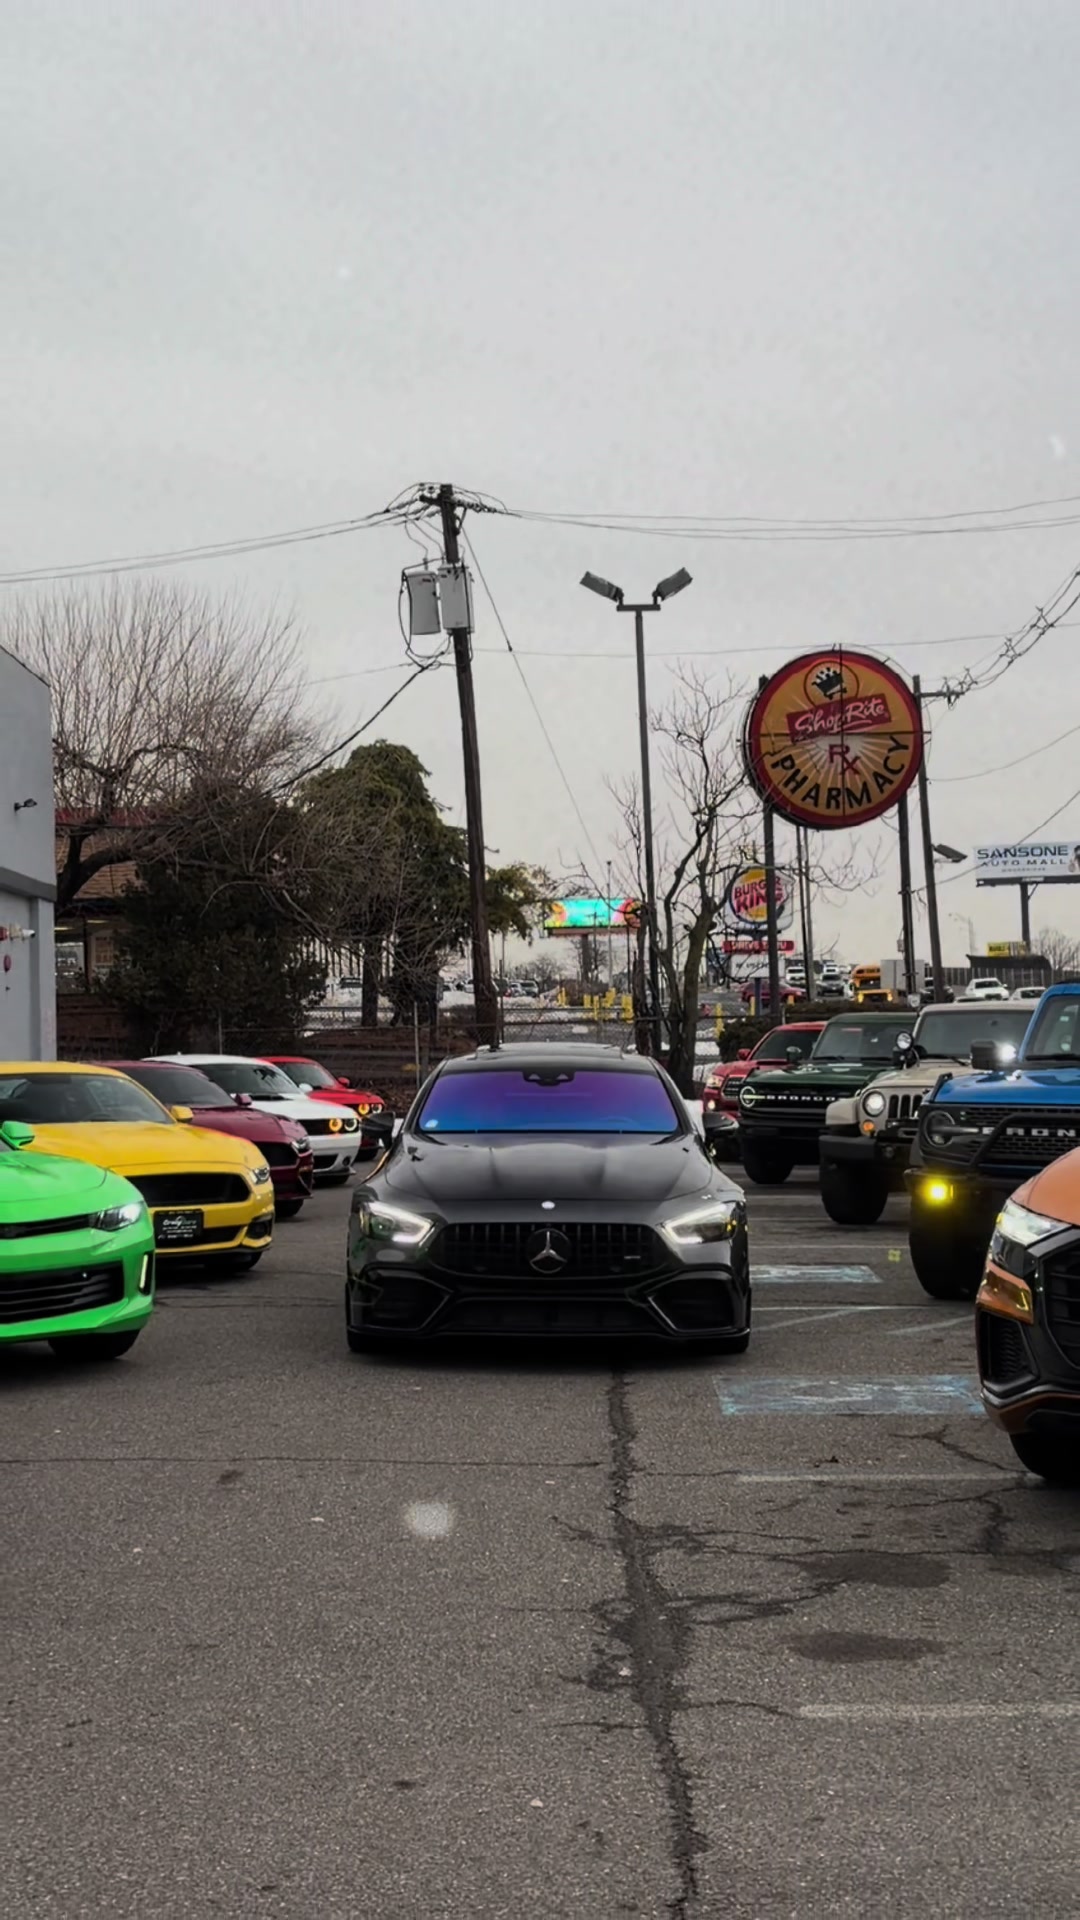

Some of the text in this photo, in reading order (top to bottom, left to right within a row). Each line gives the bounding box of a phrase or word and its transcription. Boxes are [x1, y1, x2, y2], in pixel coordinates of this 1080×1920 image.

[795, 698, 885, 734] ShopRite
[771, 736, 909, 809] PHARMACY
[977, 845, 1069, 860] SANSONE
[981, 859, 1020, 867] AUTO
[734, 876, 781, 898] BURGR
